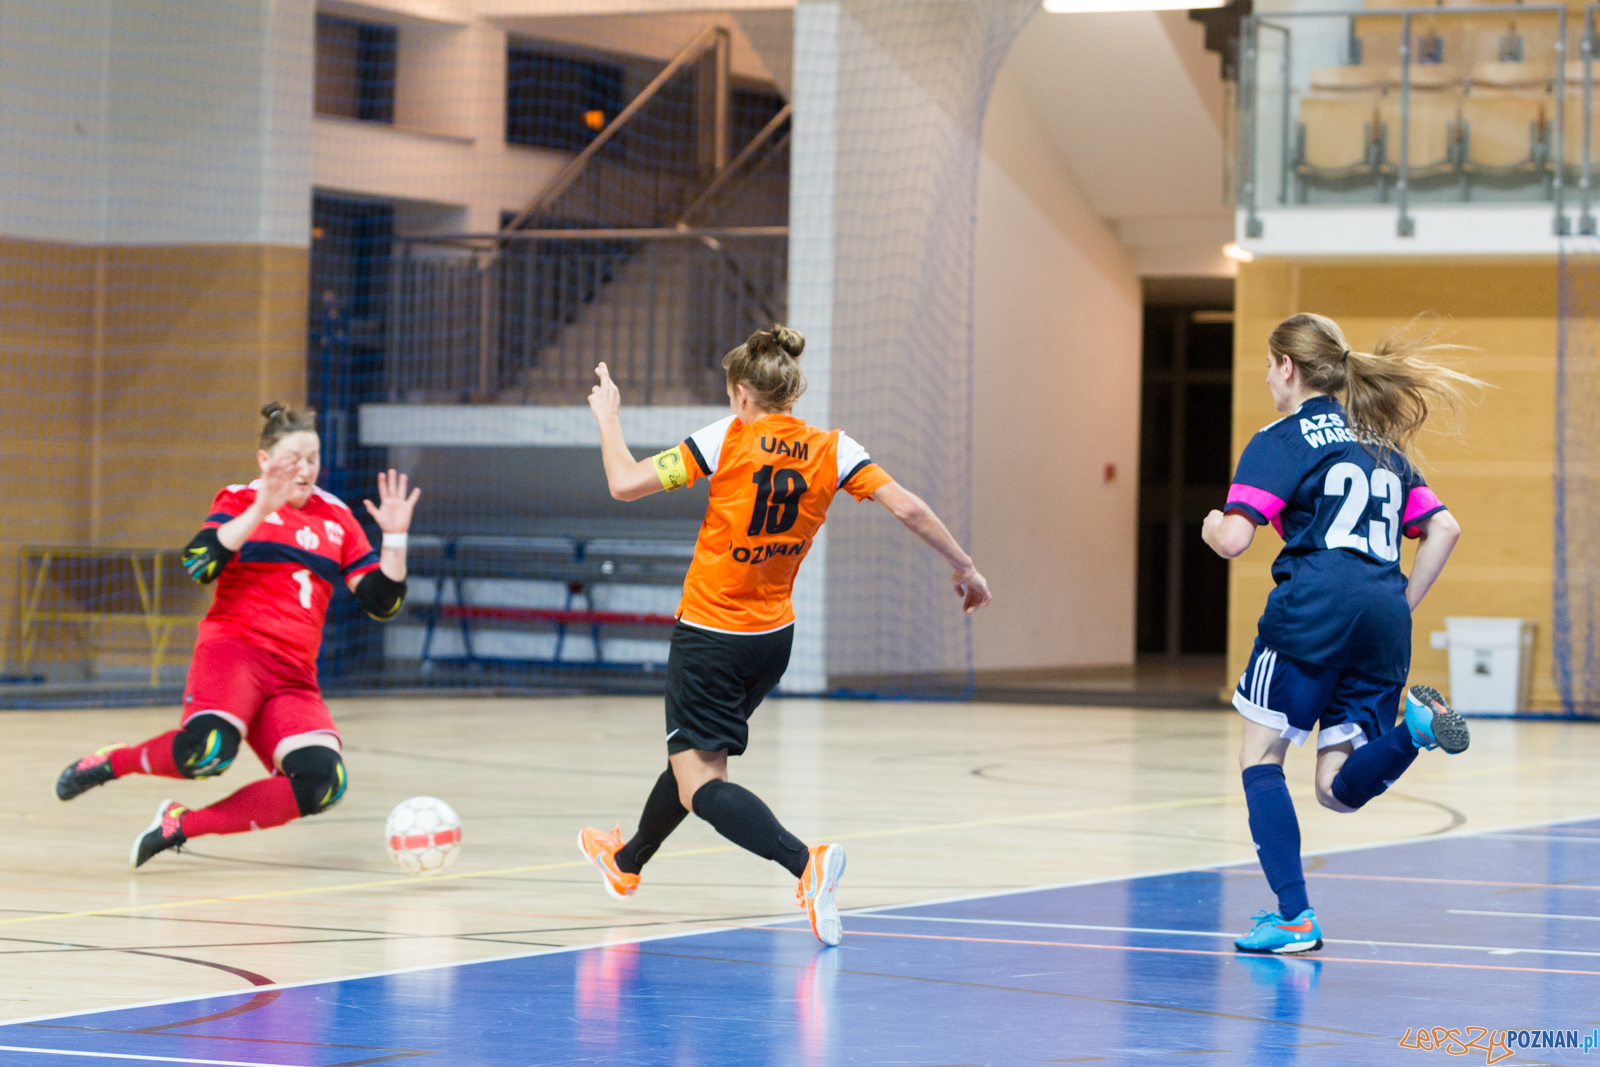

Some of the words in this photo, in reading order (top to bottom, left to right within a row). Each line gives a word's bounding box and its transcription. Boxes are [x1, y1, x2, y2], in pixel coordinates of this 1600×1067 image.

[1299, 413, 1345, 435] AZS
[760, 436, 809, 461] UAM
[1303, 427, 1399, 450] WARS
[656, 452, 680, 470] C
[747, 464, 808, 537] 19
[1323, 462, 1403, 562] 23
[728, 539, 806, 565] OZNAN
[291, 569, 313, 609] 1
